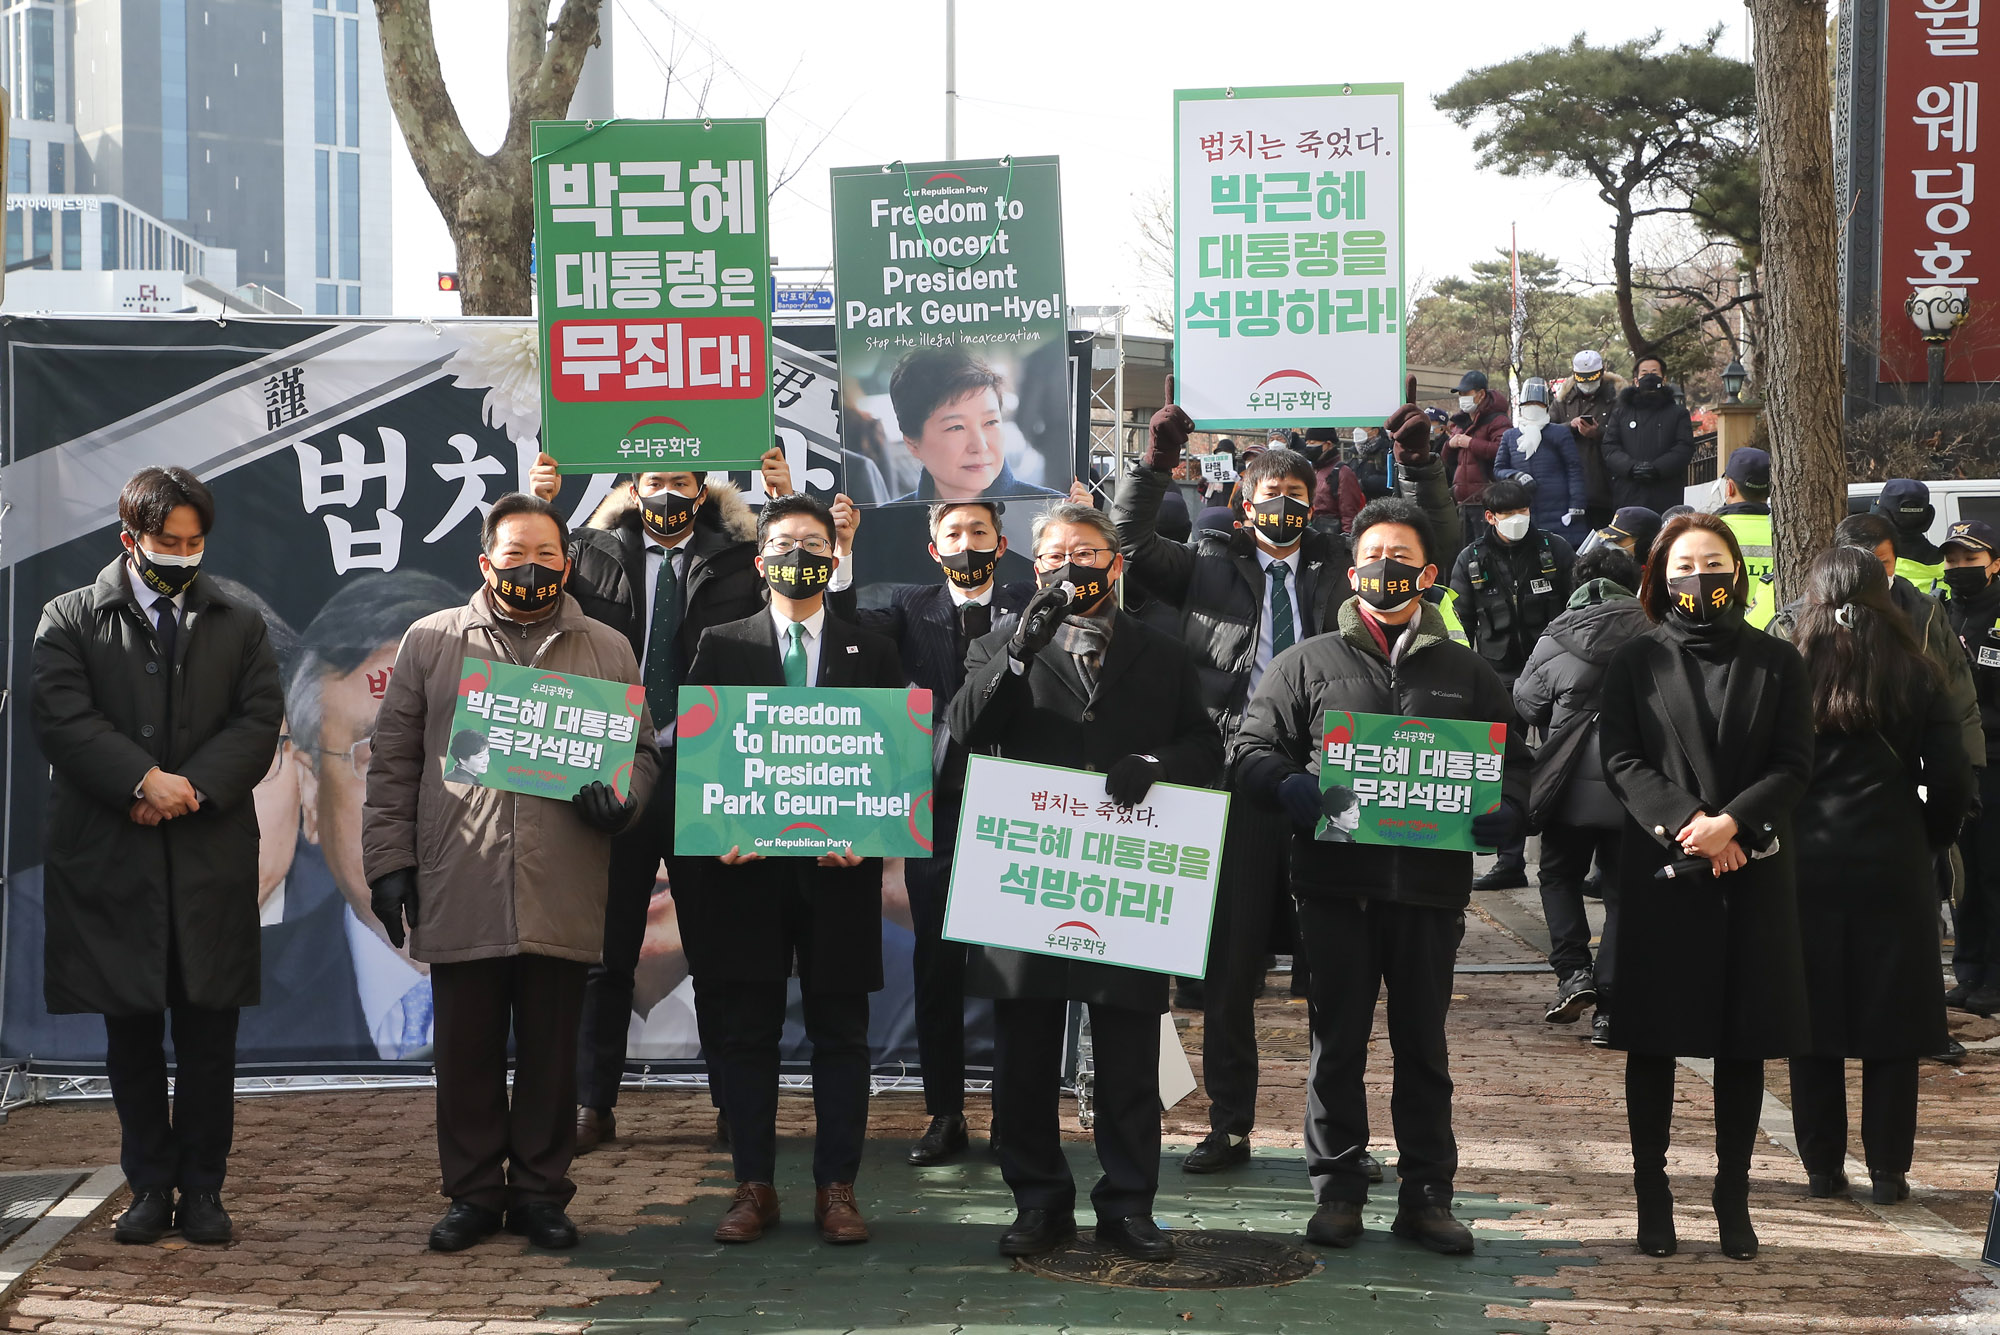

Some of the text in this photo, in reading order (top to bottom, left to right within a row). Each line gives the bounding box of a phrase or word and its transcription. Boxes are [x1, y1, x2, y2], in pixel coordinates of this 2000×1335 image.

[1199, 126, 1391, 163] 법치는 죽었다.
[547, 160, 756, 237] 박근혜
[903, 185, 989, 198] Our Republican Party
[1211, 170, 1366, 224] 박근혜
[870, 196, 1024, 228] Freedom to
[889, 229, 1010, 260] Innocent
[1199, 230, 1388, 279] 대통령을
[555, 250, 755, 309] 대통령은
[883, 263, 1018, 295] President
[818, 296, 830, 304] 134
[846, 294, 1060, 329] Park Geun-Hye!
[1185, 287, 1397, 338] 석방하라!
[865, 326, 1041, 351] Stop the illegal incarceration
[561, 323, 750, 391] 무죄다!
[264, 367, 309, 431] 謹
[1246, 390, 1332, 412] 우리공화당
[617, 436, 701, 458] 우리공화당
[645, 508, 688, 528] 탄핵 무효
[1258, 513, 1304, 528] 탄핵 무효
[501, 579, 558, 600] 탄핵 무효
[767, 564, 828, 585] 탄핵 무효
[1075, 581, 1100, 600] 무효
[1361, 577, 1410, 595] 탄핵 무효
[530, 682, 574, 700] 우리공화당
[466, 690, 635, 743] 박근혜 대통령
[746, 692, 861, 726] Freedom
[487, 725, 604, 770] 즉각석방!
[733, 722, 884, 755] to Innocent
[1392, 730, 1436, 744] 우리공화당
[744, 757, 872, 788] President
[1327, 742, 1502, 782] 박근혜 대통령
[702, 783, 911, 817] Park Geun-hye!
[1030, 790, 1159, 828] 법치는 죽었다.
[1353, 778, 1472, 814] 무죄석방!
[754, 837, 852, 848] Our Republican Party
[975, 814, 1211, 881] 박근혜 대통령을
[1000, 862, 1174, 926] 석방하라!
[1044, 933, 1107, 956] 우리공화당
